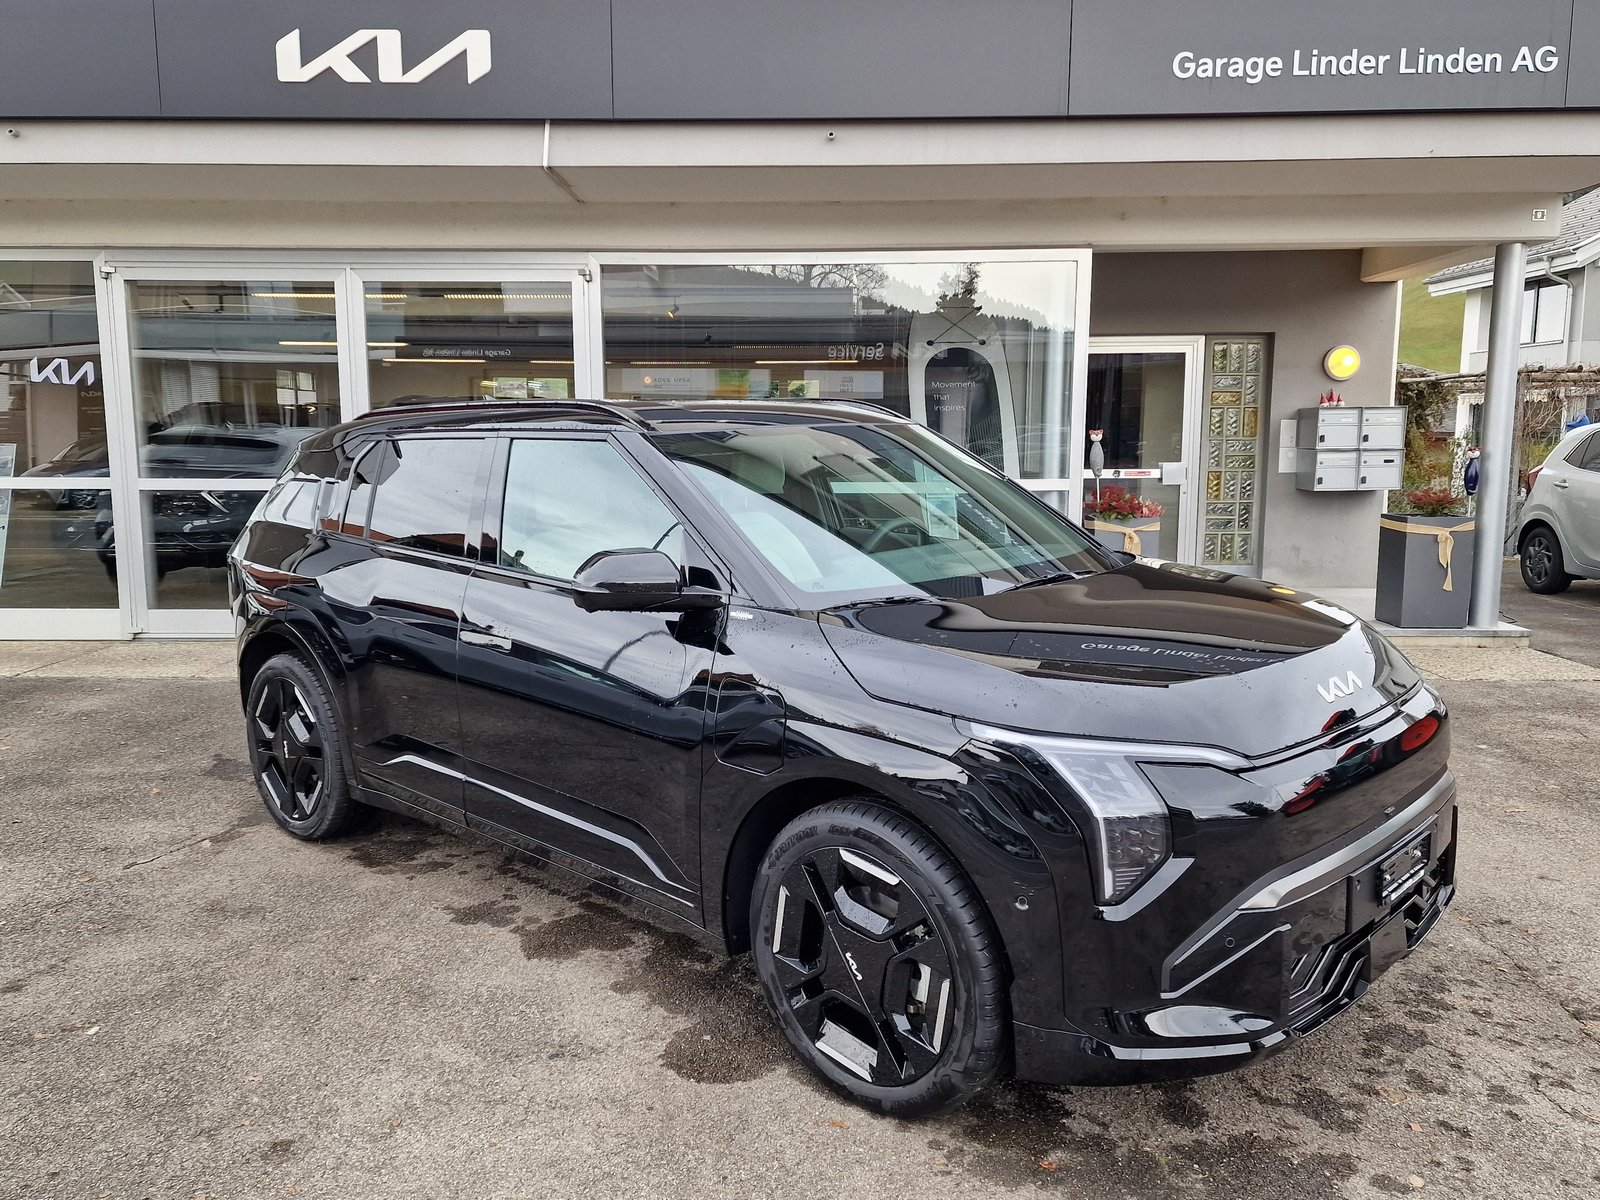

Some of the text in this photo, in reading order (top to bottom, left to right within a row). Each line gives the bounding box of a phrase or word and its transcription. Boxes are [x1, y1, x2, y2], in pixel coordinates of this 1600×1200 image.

[275, 28, 492, 84] KIA
[1172, 45, 1560, 84] Garage Linder Linden AG
[29, 356, 95, 386] KIA
[931, 381, 976, 389] Movement
[933, 403, 966, 412] inspires
[1317, 670, 1363, 703] KIA
[845, 952, 863, 981] KIA
